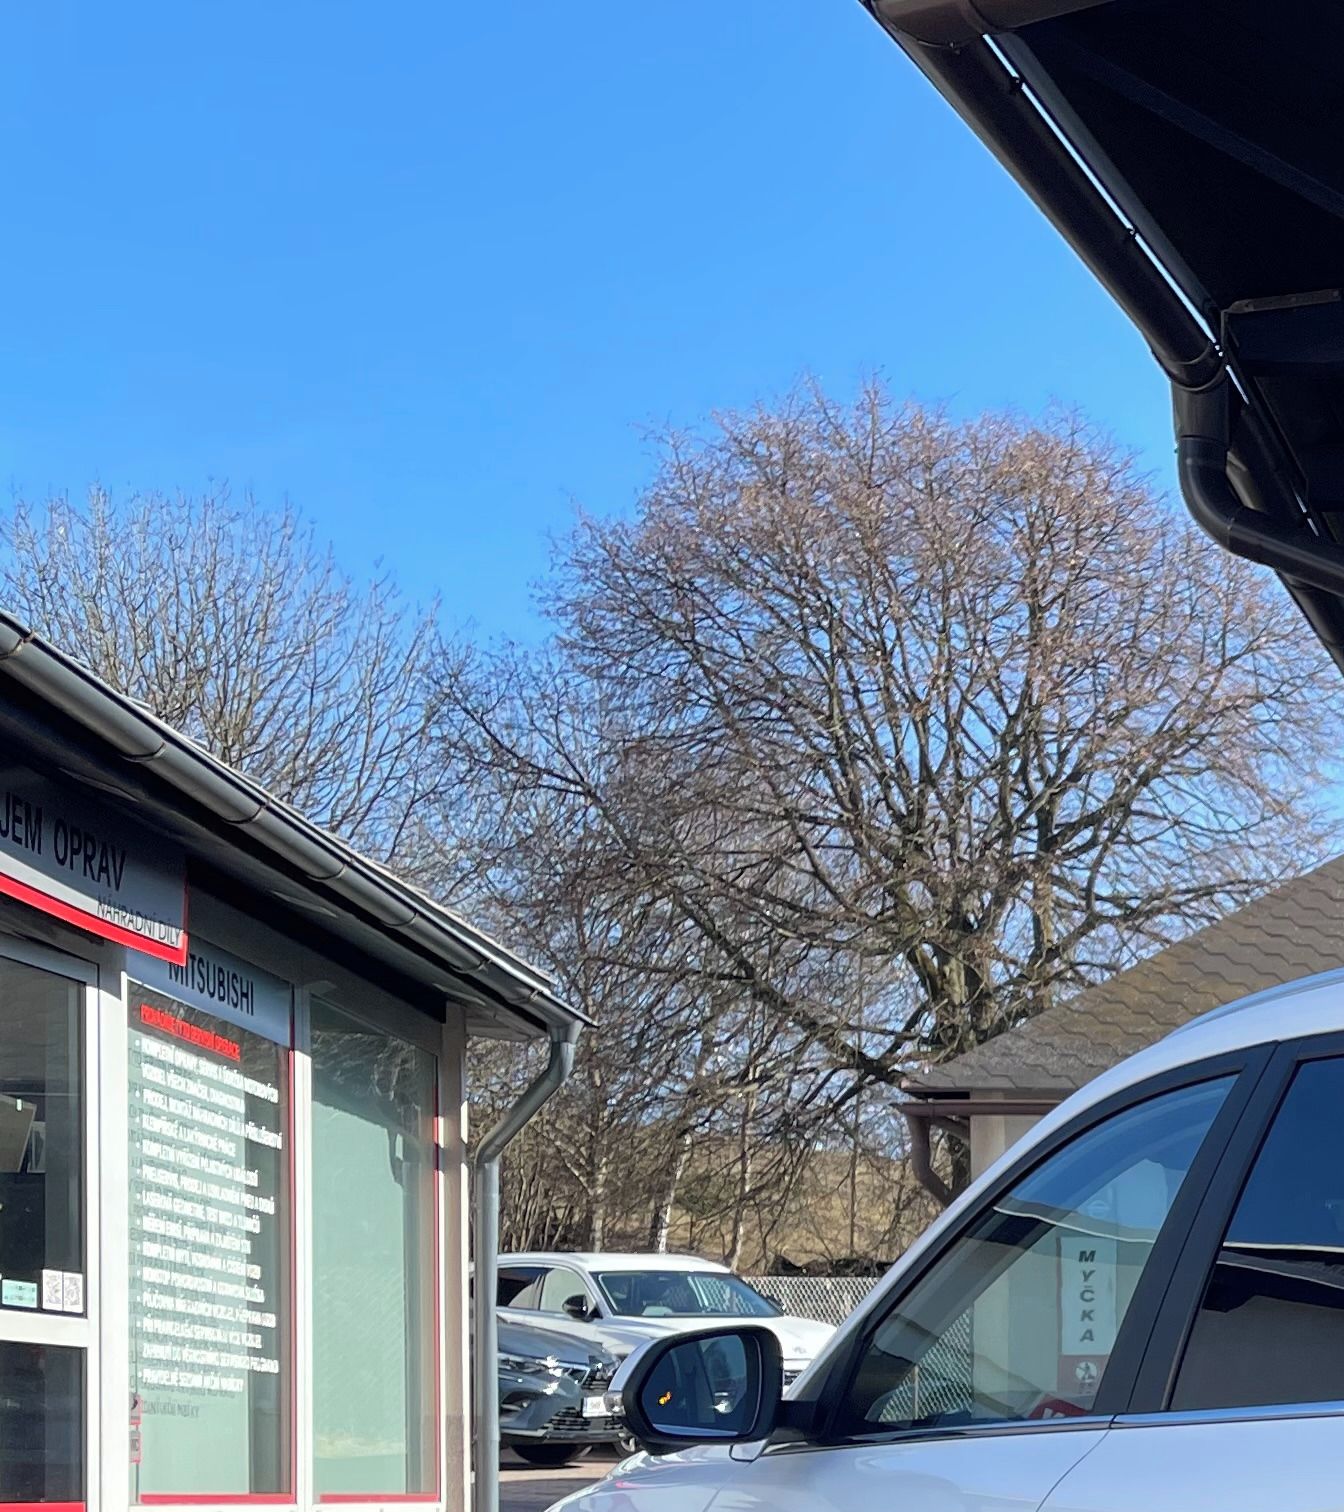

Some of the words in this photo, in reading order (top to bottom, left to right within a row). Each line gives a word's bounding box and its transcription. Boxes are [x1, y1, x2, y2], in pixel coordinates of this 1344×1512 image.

[53, 818, 126, 891] OPRAV
[97, 894, 157, 937] NÁHRADNÍ
[158, 915, 183, 946] DÍLY
[1078, 1250, 1096, 1343] MYČKA
